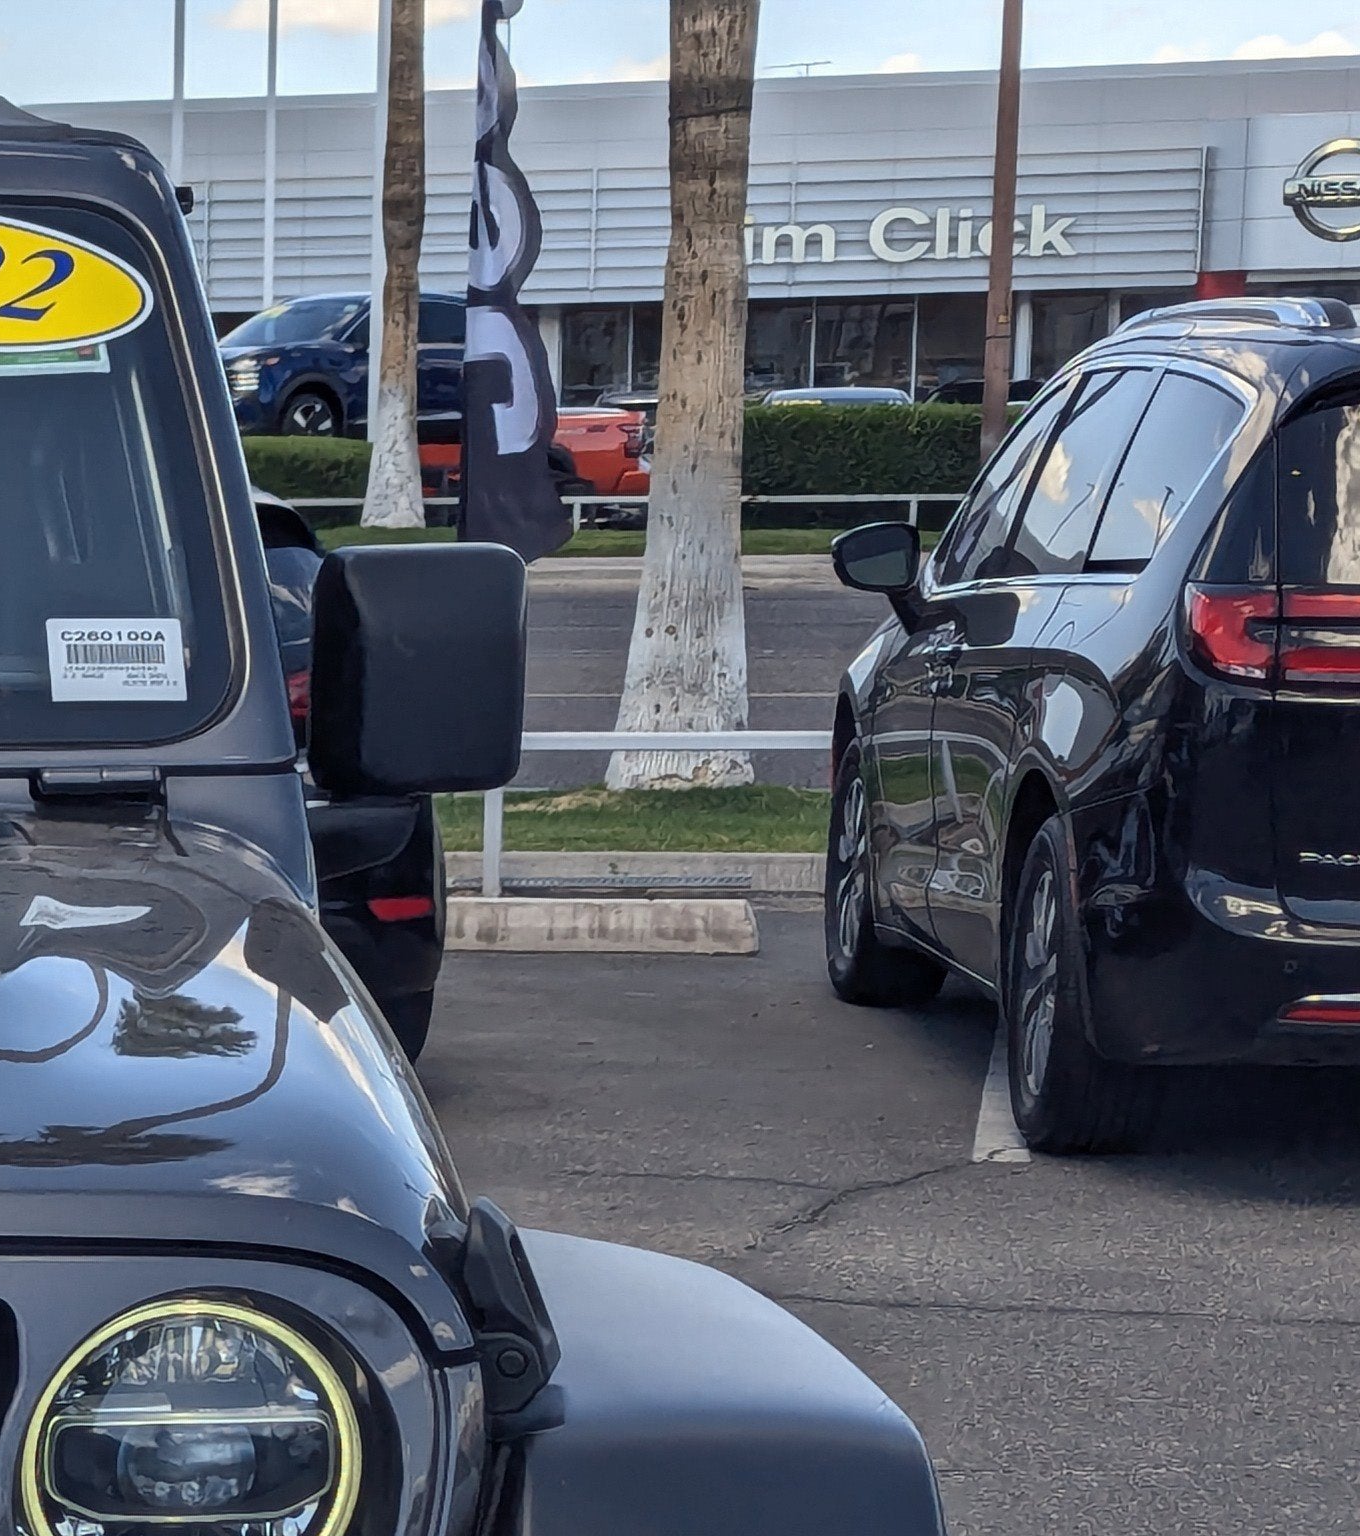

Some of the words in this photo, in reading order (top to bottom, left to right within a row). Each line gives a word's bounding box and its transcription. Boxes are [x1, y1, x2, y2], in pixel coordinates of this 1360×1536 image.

[1298, 181, 1360, 200] NISS
[743, 213, 836, 265] im
[869, 204, 1078, 263] Click
[1299, 852, 1360, 866] PAC
